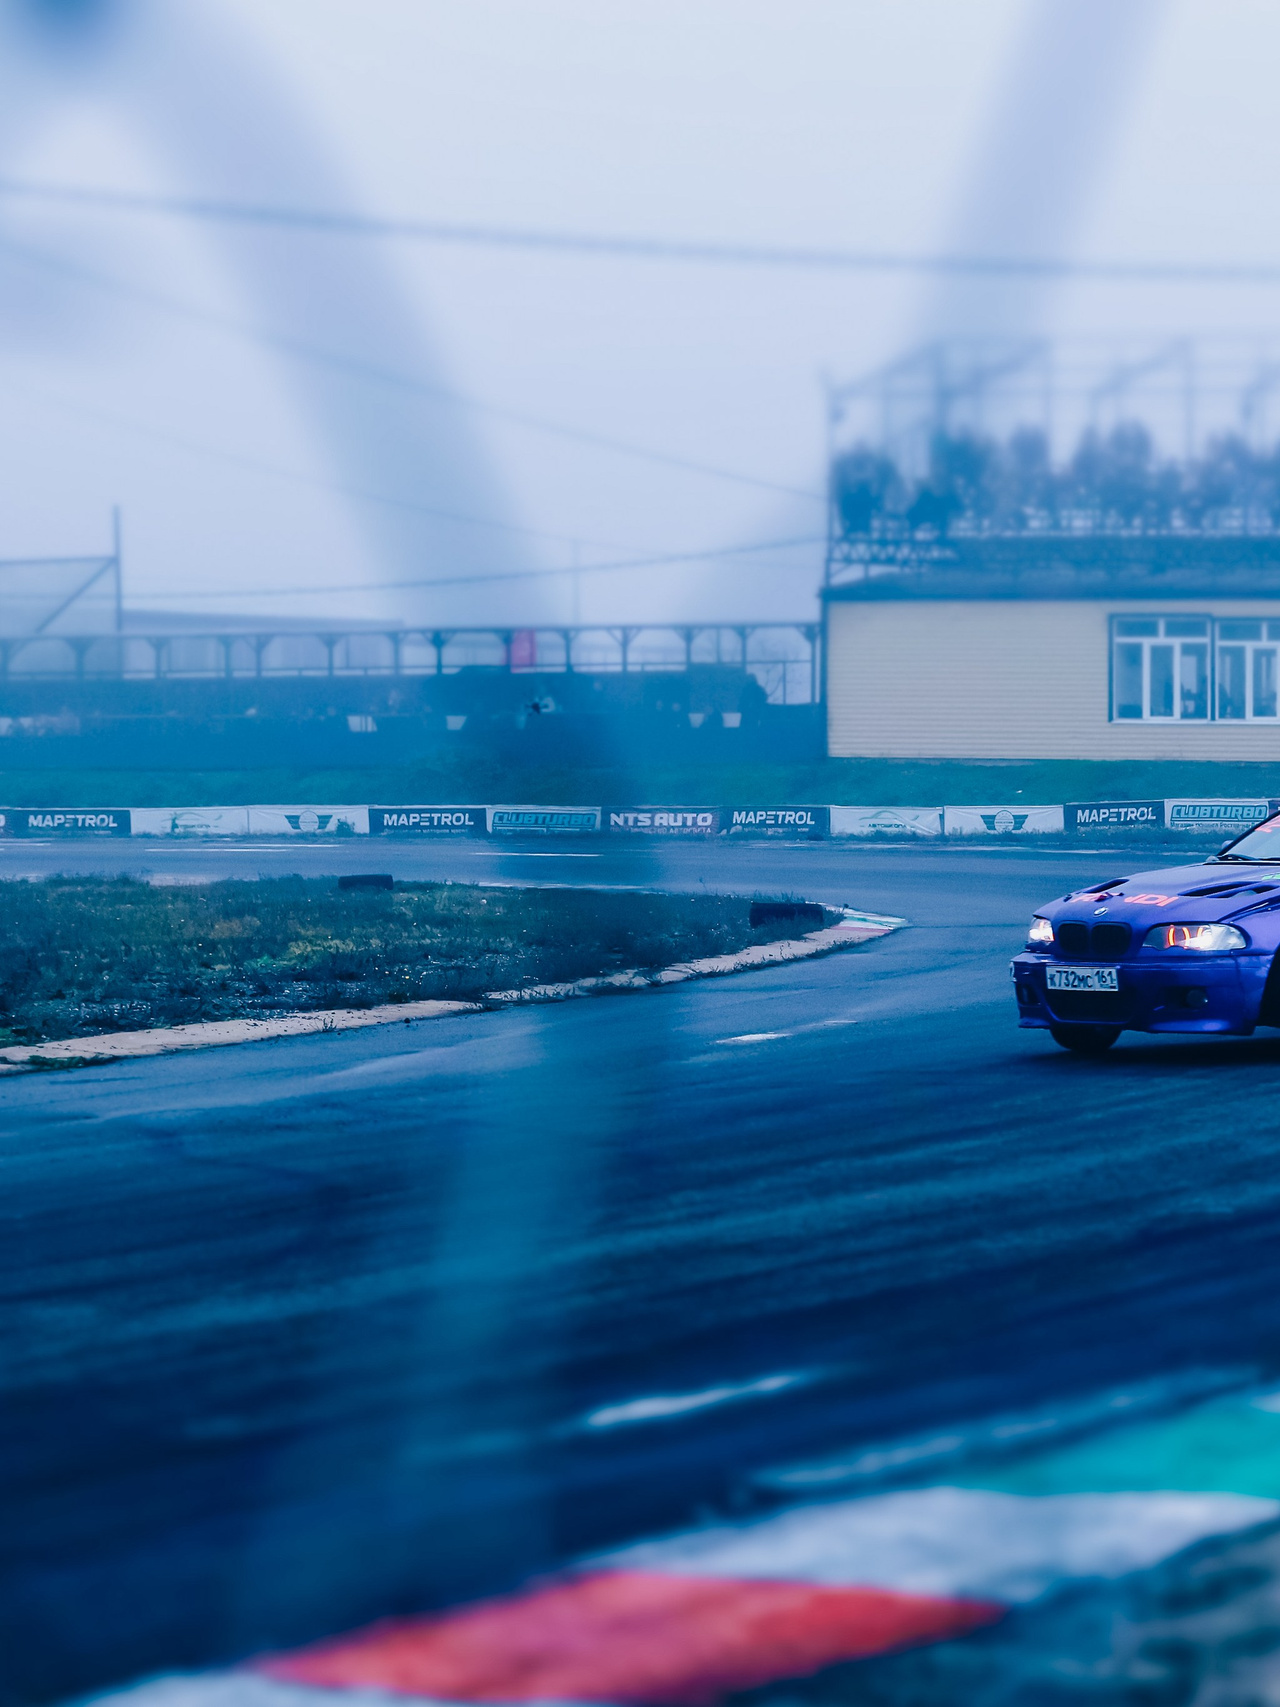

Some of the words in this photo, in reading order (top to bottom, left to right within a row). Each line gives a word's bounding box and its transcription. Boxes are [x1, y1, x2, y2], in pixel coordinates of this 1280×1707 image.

[383, 813, 475, 826] MAPETROL
[494, 812, 596, 825] CLUBTURBO
[610, 813, 652, 826] NTS
[654, 813, 713, 826] AUTO
[733, 811, 815, 824] MAPETROL
[1077, 807, 1156, 823] MAPETROL
[1172, 806, 1267, 820] CLUBTURBO
[28, 814, 118, 827] MAPETROL
[1095, 970, 1114, 984] 161
